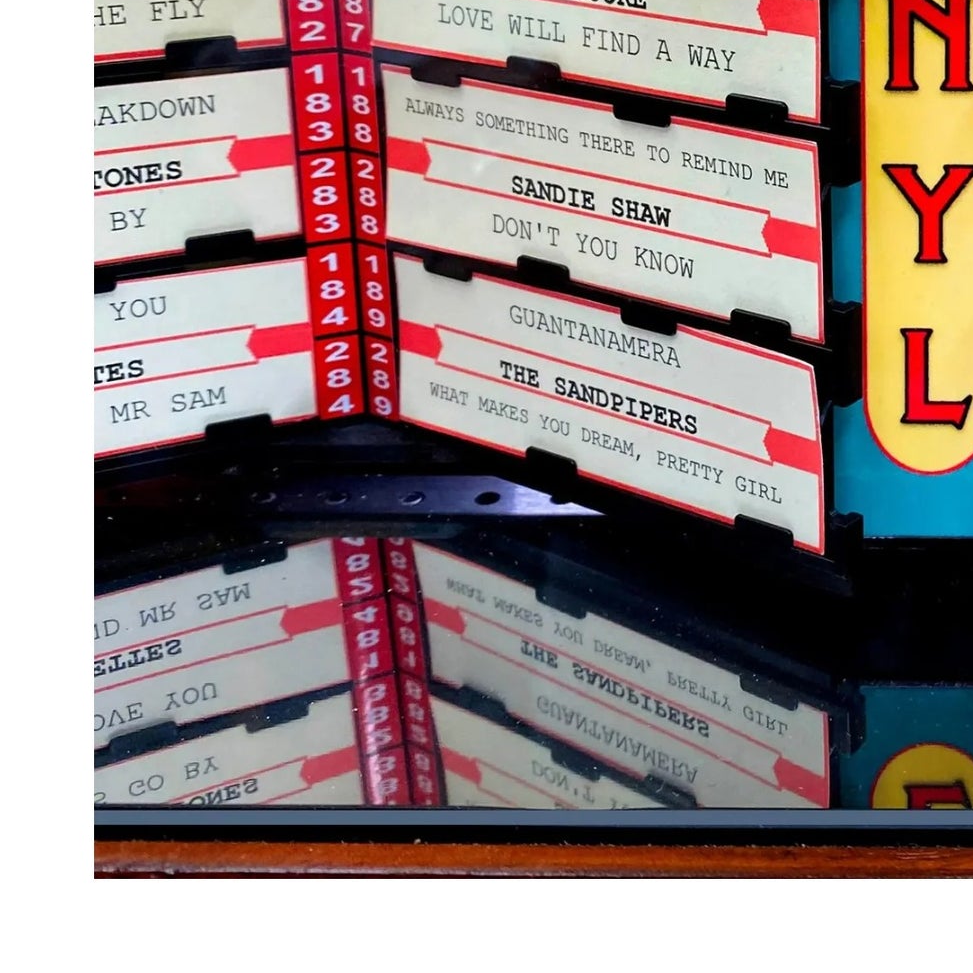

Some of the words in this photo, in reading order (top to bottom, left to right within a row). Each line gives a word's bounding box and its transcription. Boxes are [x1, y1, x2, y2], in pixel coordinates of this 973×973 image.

[438, 3, 493, 31] LOVE
[508, 14, 565, 43] WILL
[583, 27, 640, 55] FIND
[656, 39, 672, 62] A
[688, 44, 735, 72] WAY
[306, 65, 333, 141] 183
[352, 67, 371, 142] 188
[406, 98, 464, 122] ALWAYS
[476, 111, 568, 143] SOMETHING
[580, 132, 635, 157] THERE
[647, 145, 670, 163] TO
[682, 152, 752, 180] REMIND
[764, 169, 788, 188] ME
[109, 208, 146, 231] BY
[311, 158, 339, 233] 283
[358, 160, 377, 234] 288
[512, 176, 595, 211] SANDIE
[612, 197, 671, 227] SHAW
[493, 214, 560, 247] DON'T
[576, 233, 617, 260] YOU
[635, 246, 693, 278] KNOW
[109, 296, 166, 321] YOU
[321, 253, 348, 324] 184
[366, 256, 384, 327] 189
[510, 305, 681, 368] GUANTANAMERA
[110, 401, 150, 423] MR
[172, 387, 226, 412] SAM
[326, 342, 353, 412] 284
[372, 344, 391, 414] 289
[500, 360, 539, 388] THE
[551, 377, 697, 436] SANDPIPERS
[430, 382, 468, 406] WHAT
[479, 396, 528, 423] MAKES
[539, 414, 570, 436] YOU
[582, 427, 640, 461] DREAM,
[657, 450, 723, 484] PRETTY
[735, 476, 781, 504] GIRL
